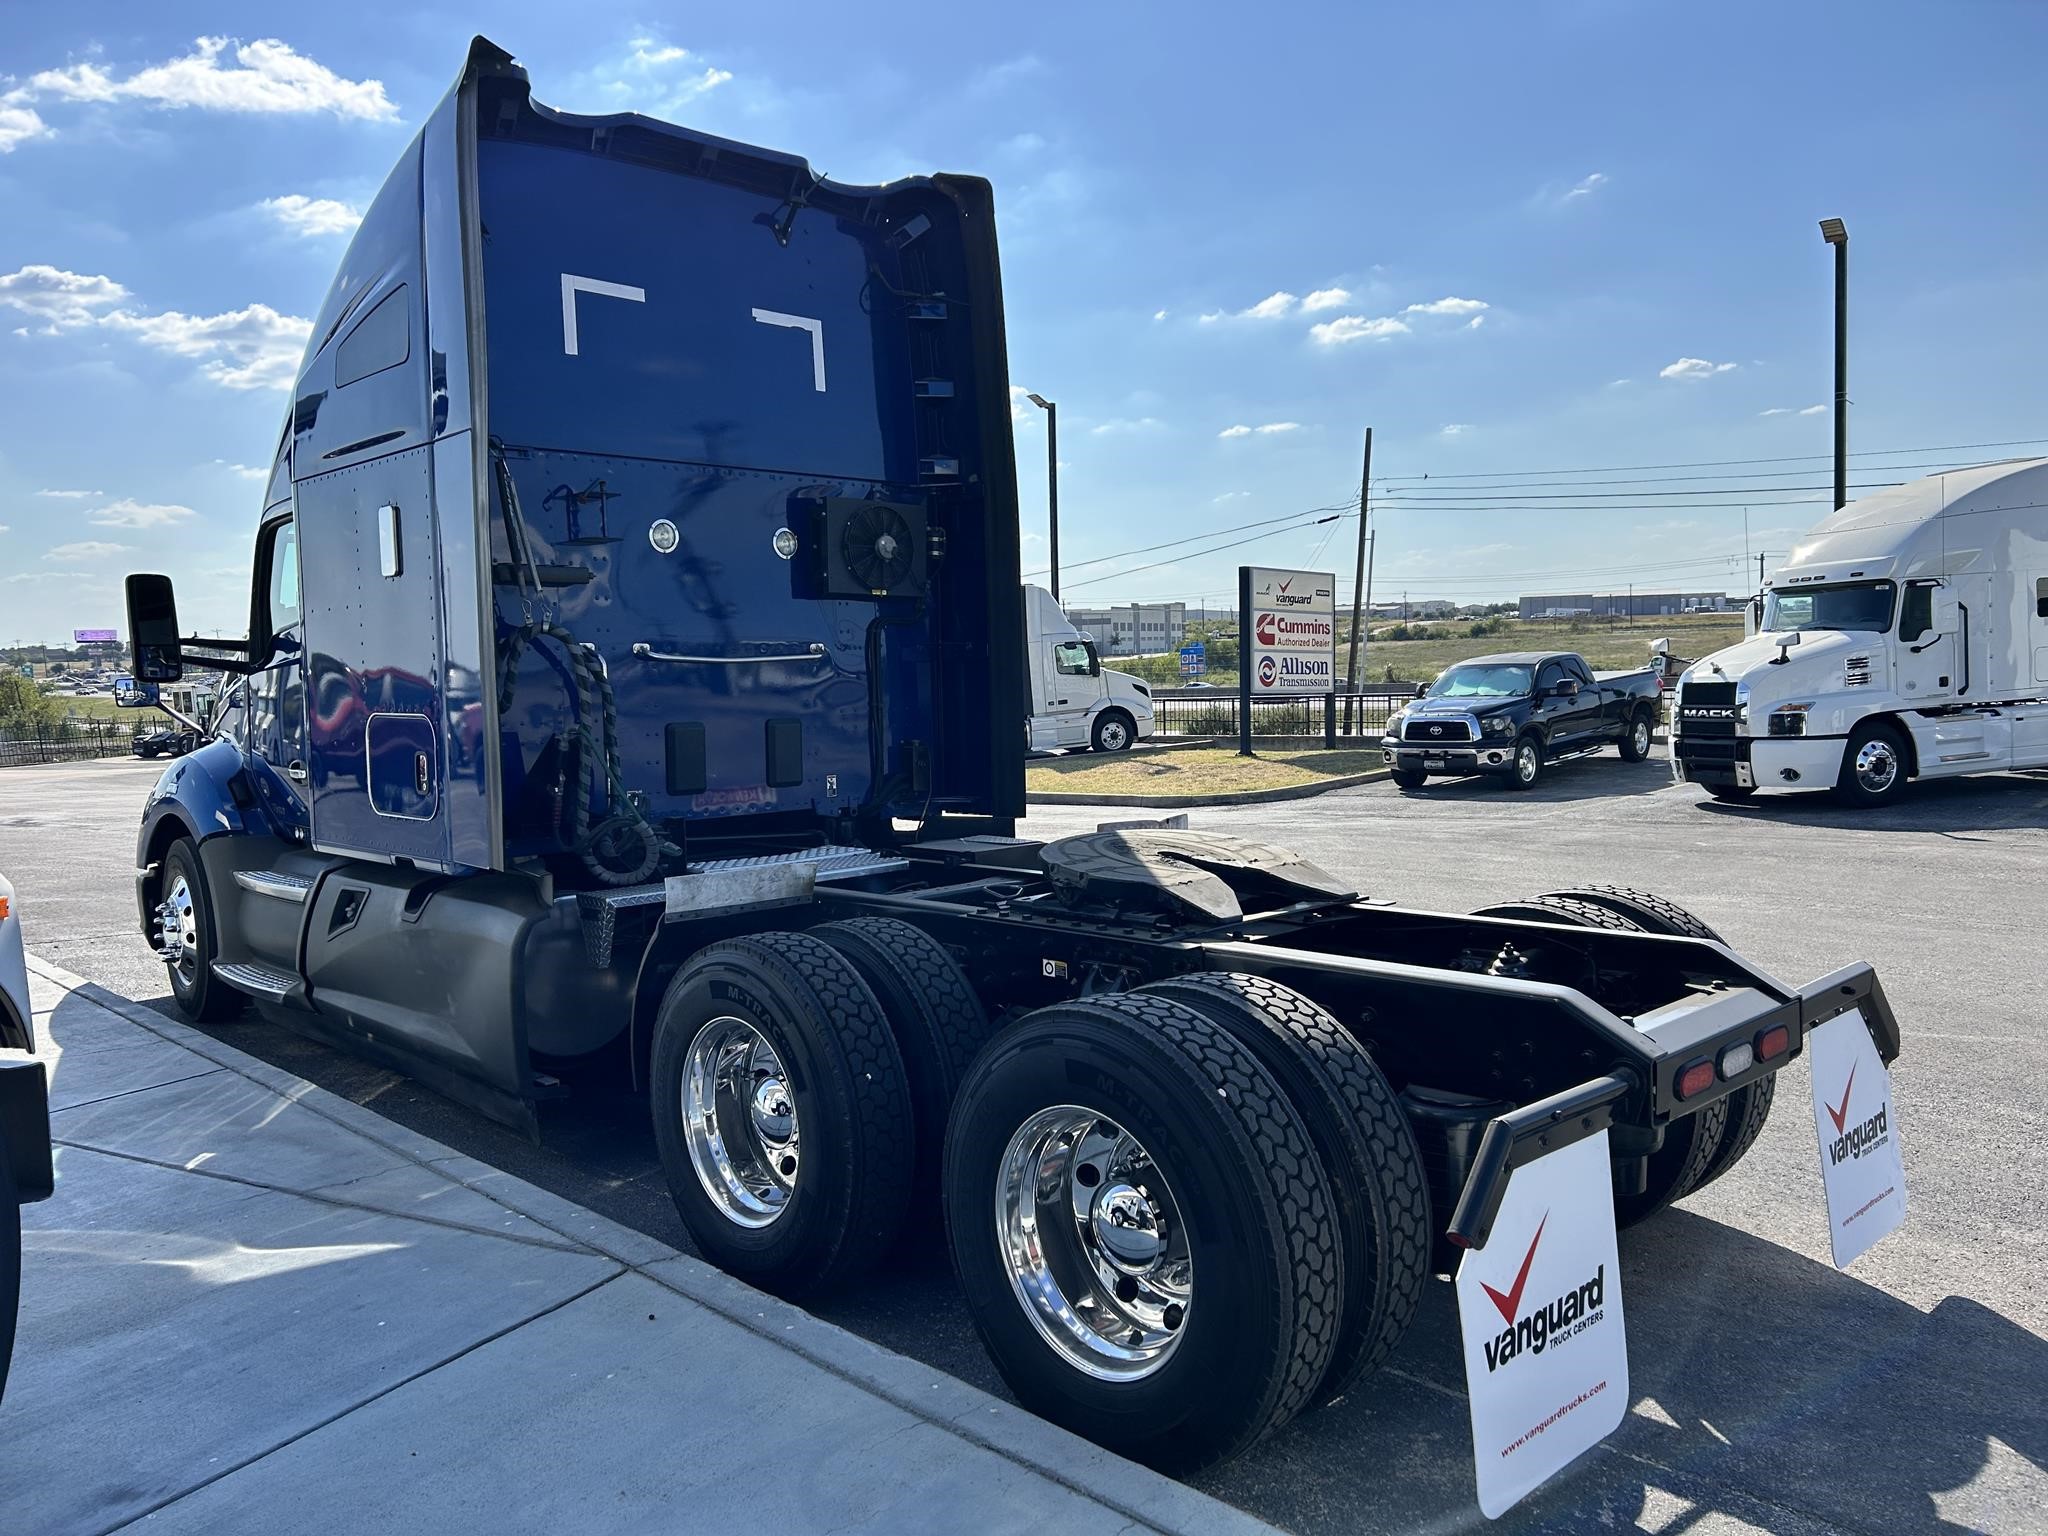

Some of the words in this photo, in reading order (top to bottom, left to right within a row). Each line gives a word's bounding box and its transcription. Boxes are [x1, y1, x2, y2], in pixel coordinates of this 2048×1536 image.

[1276, 594, 1312, 606] vanguard
[1277, 618, 1330, 634] Cummins
[1277, 638, 1310, 647] Authorized
[1311, 639, 1330, 647] Dealer
[1279, 657, 1329, 675] Allison
[1279, 677, 1329, 687] Transmission
[1684, 710, 1735, 718] MACK
[1829, 1102, 1887, 1166] vanguard
[1484, 1264, 1604, 1373] vanguard
[1549, 1328, 1573, 1350] TRUCK
[1574, 1311, 1604, 1335] CENTERS
[1501, 1379, 1607, 1458] www.vanguardtrucks.com
